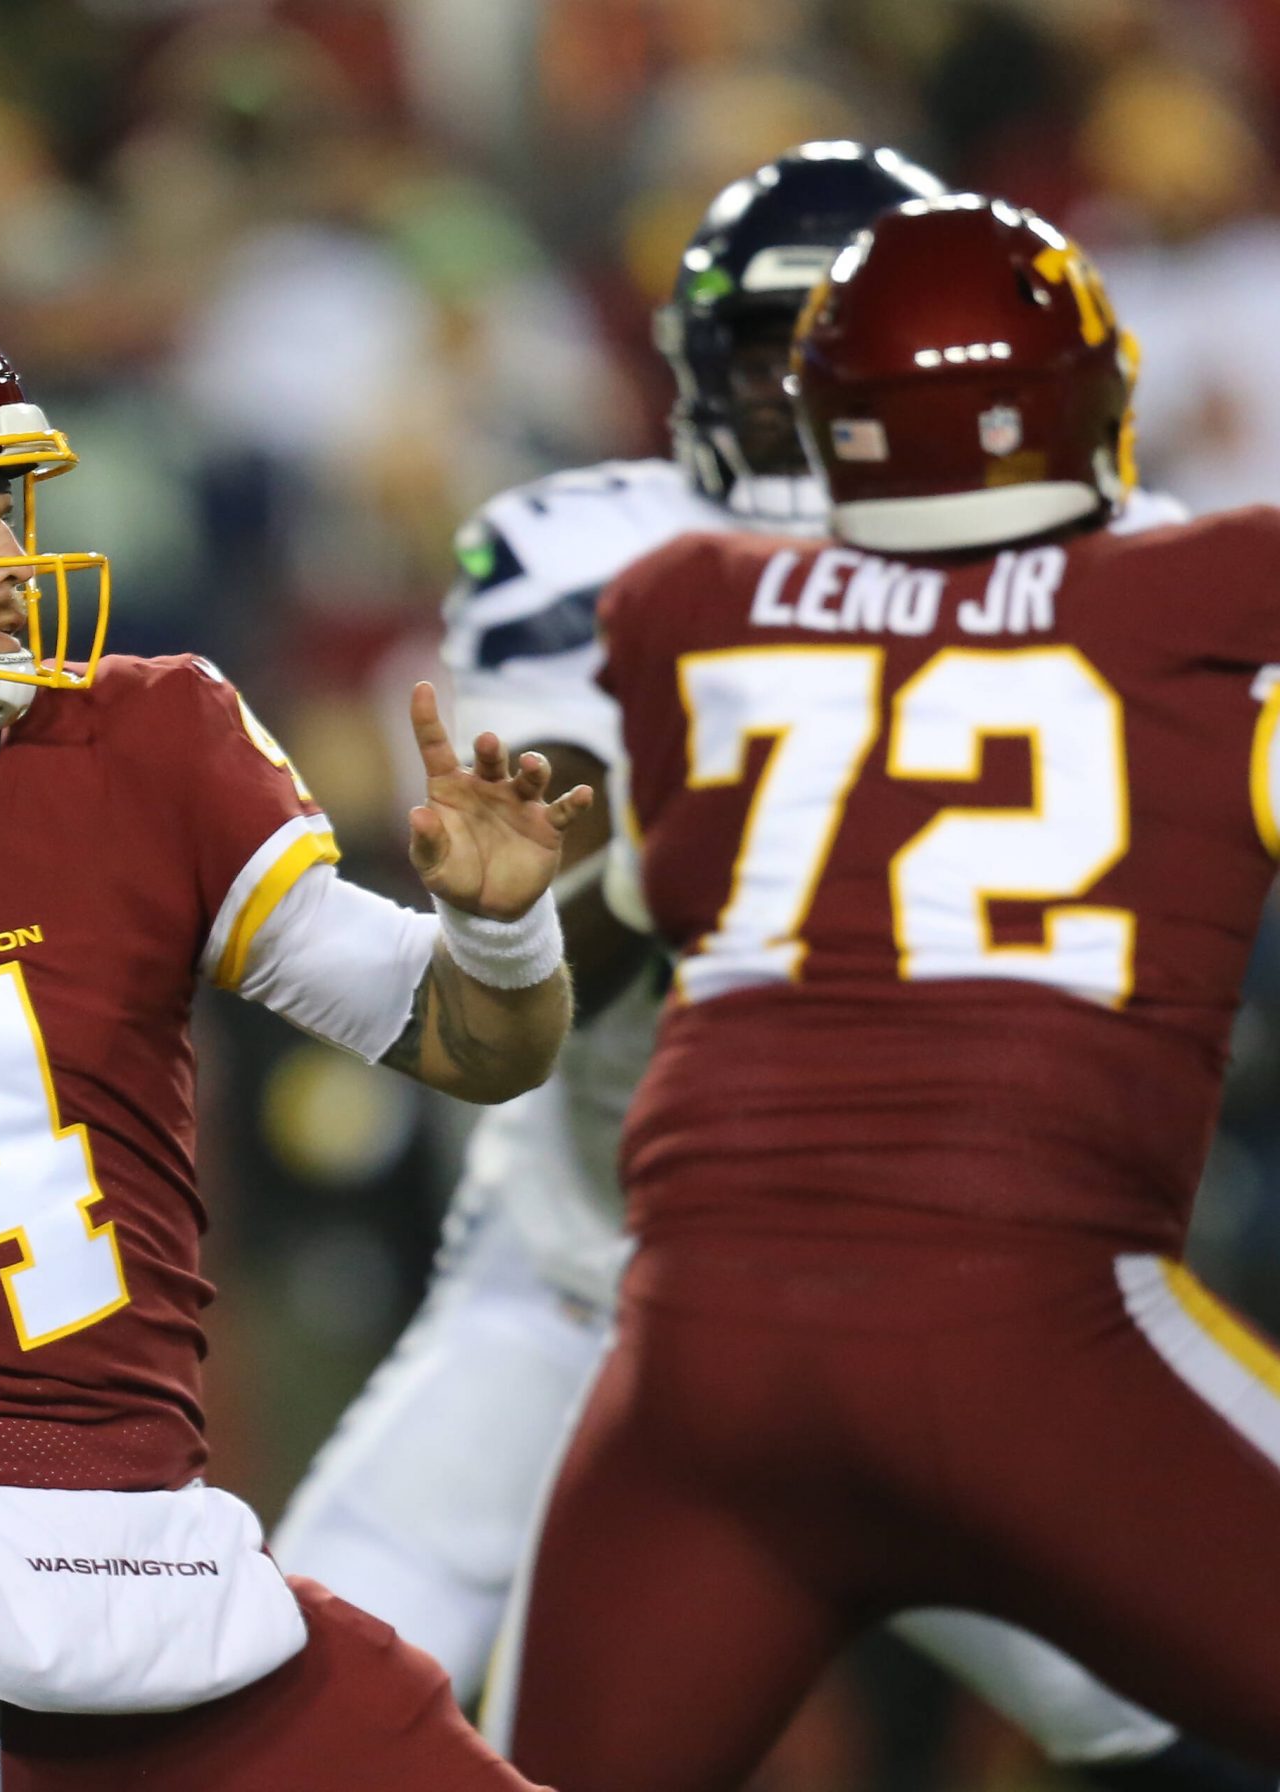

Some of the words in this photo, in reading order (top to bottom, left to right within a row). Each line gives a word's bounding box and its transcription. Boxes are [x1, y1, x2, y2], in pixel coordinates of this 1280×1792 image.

[749, 548, 948, 637] LENO
[956, 545, 1067, 635] JR
[676, 642, 1137, 1013] 72
[25, 1557, 220, 1577] WASHINGTON
